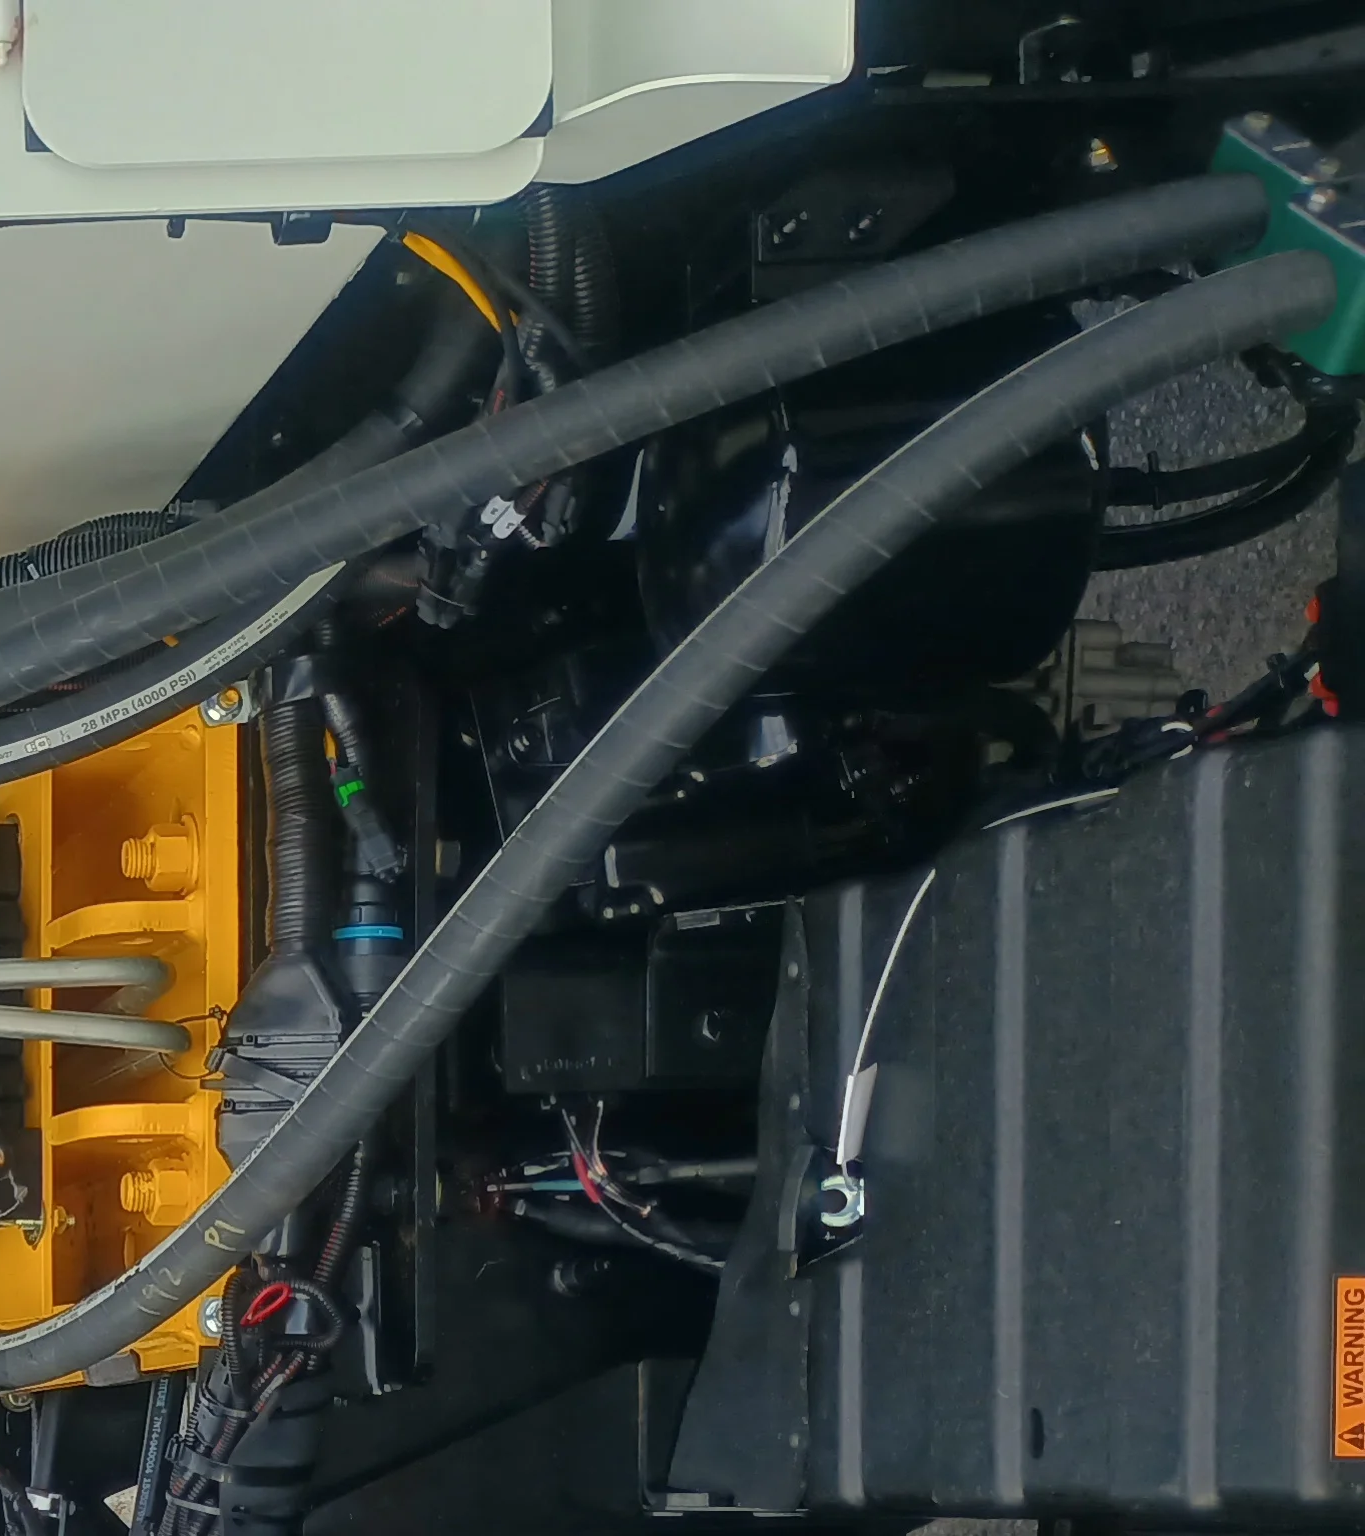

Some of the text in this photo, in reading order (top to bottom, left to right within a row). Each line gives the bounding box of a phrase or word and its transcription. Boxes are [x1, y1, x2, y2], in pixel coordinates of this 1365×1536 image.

[81, 669, 197, 734] 28 MPa (4000 PSI)
[1342, 1288, 1365, 1408] WARNING
